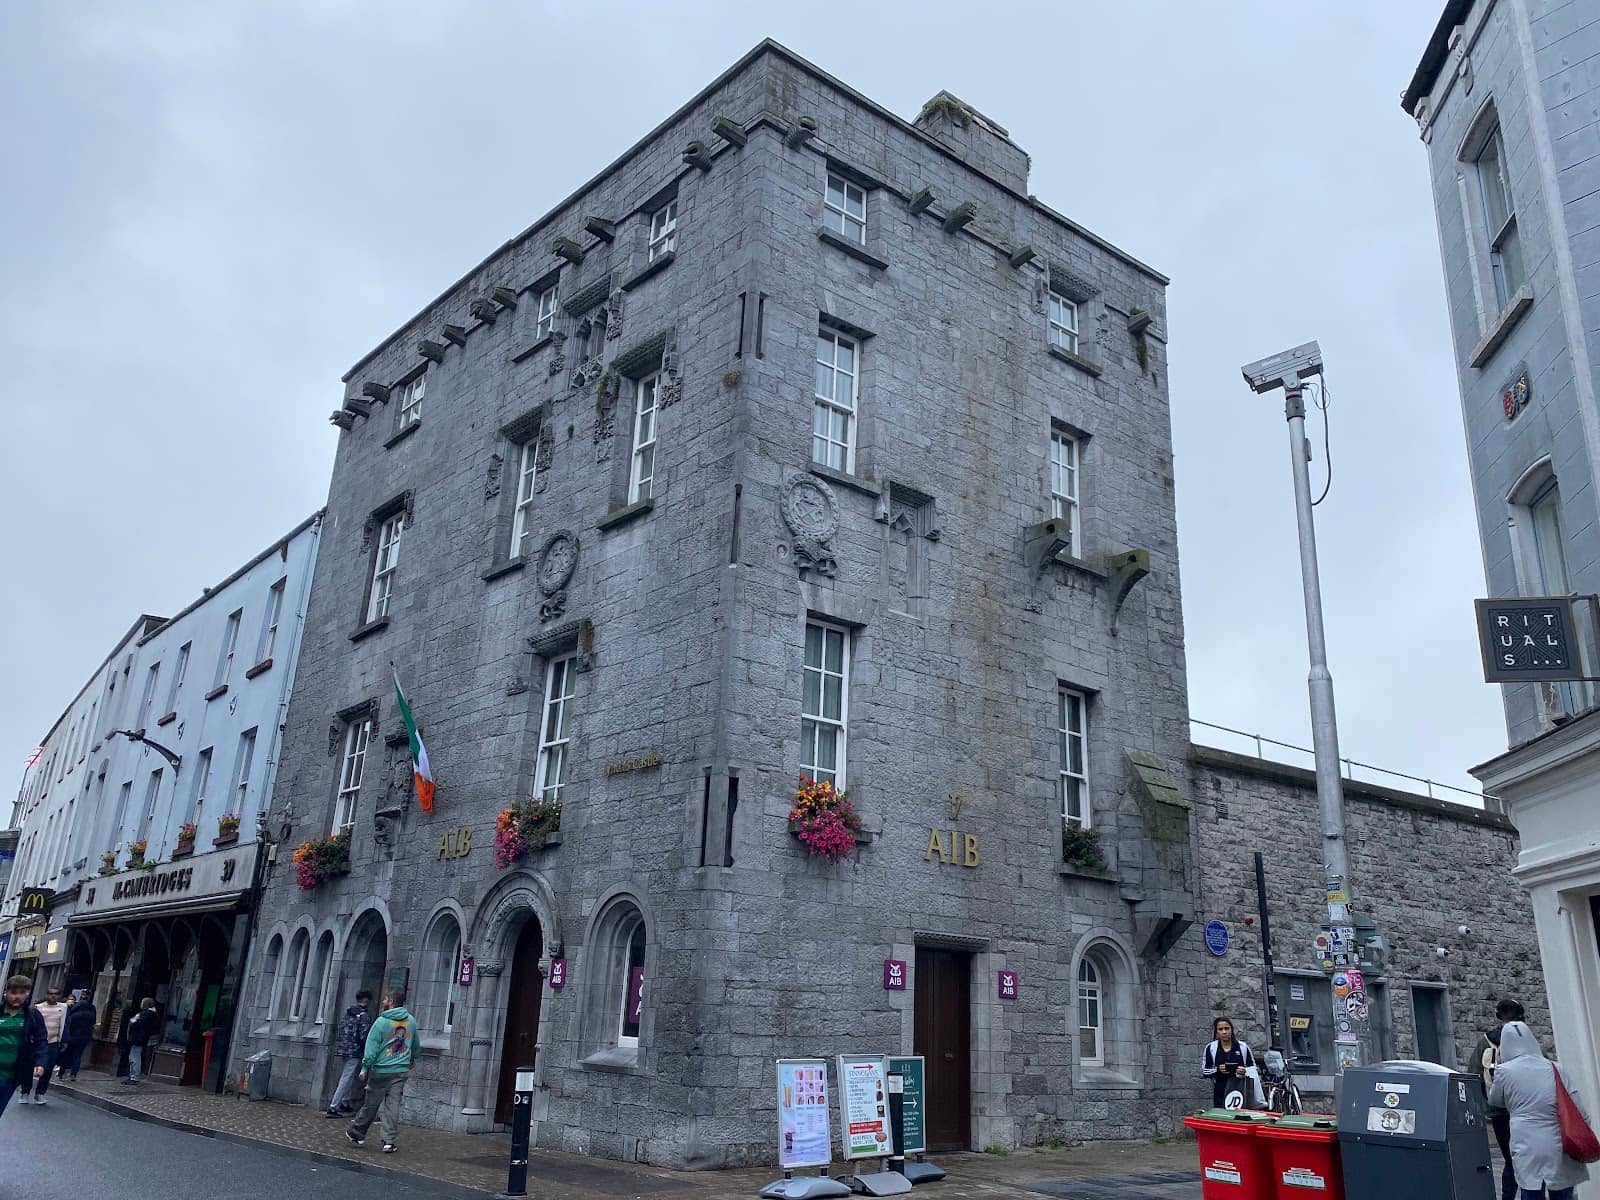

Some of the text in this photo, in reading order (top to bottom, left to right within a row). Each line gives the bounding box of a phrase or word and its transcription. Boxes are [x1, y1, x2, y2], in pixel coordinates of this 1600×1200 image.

[437, 826, 472, 861] AIB
[924, 828, 980, 867] AIB
[551, 975, 562, 984] AIB
[889, 977, 902, 986] AIB
[1002, 986, 1014, 995] AIB
[1227, 1096, 1241, 1108] JD
